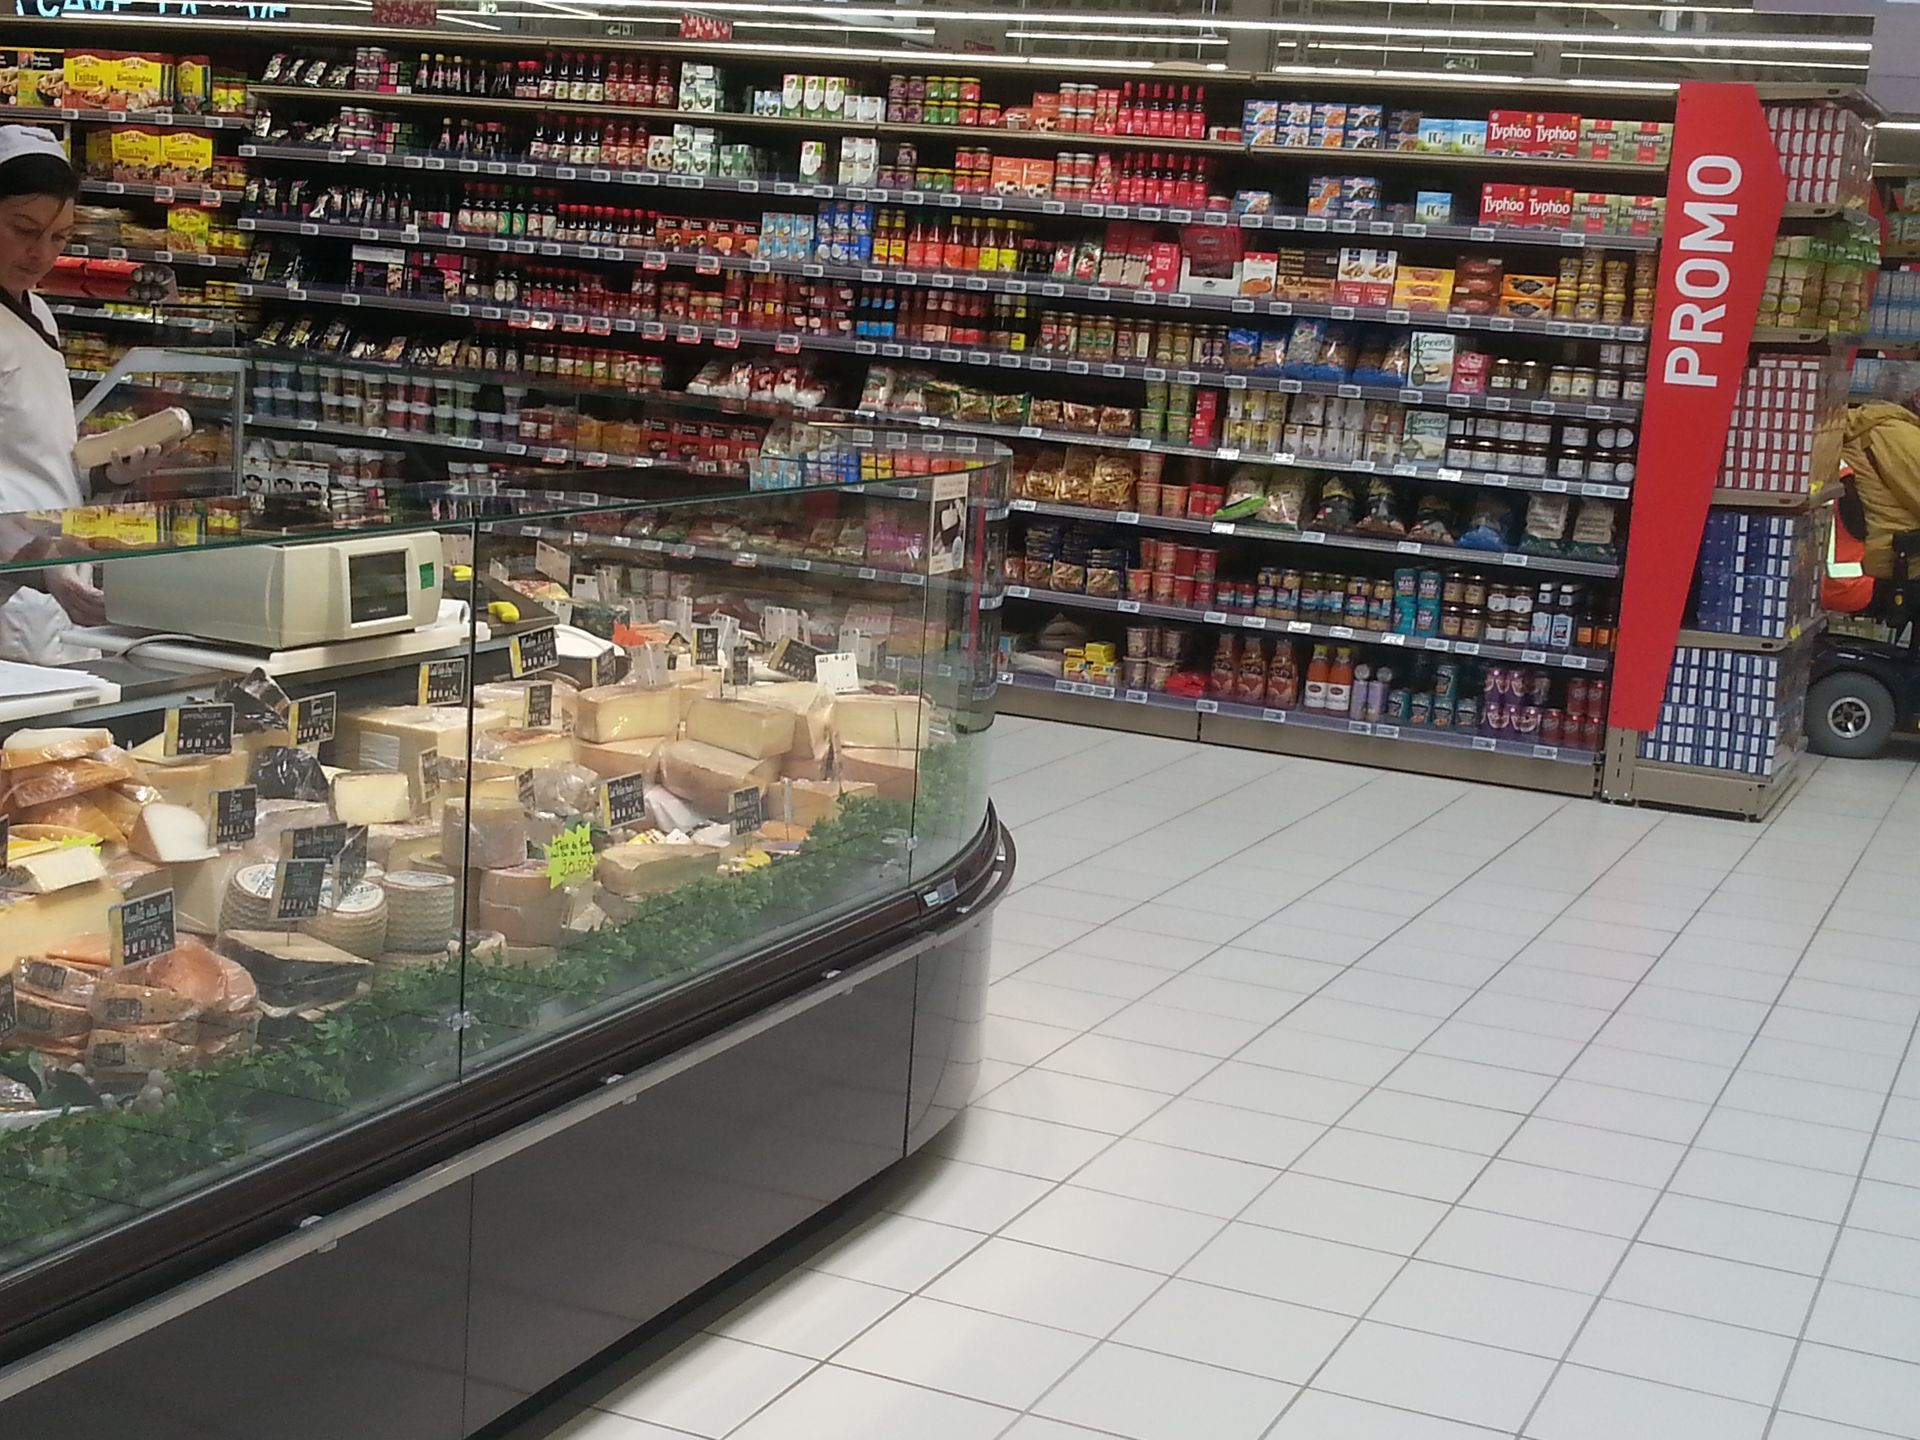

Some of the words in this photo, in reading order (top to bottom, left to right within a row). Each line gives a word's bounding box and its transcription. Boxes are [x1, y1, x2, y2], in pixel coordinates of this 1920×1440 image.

[1490, 122, 1532, 141] Typhoo
[1535, 124, 1578, 143] Typhoo
[1483, 195, 1525, 214] Typhoo
[1529, 198, 1571, 217] Typhoo
[1664, 155, 1742, 388] PROMO
